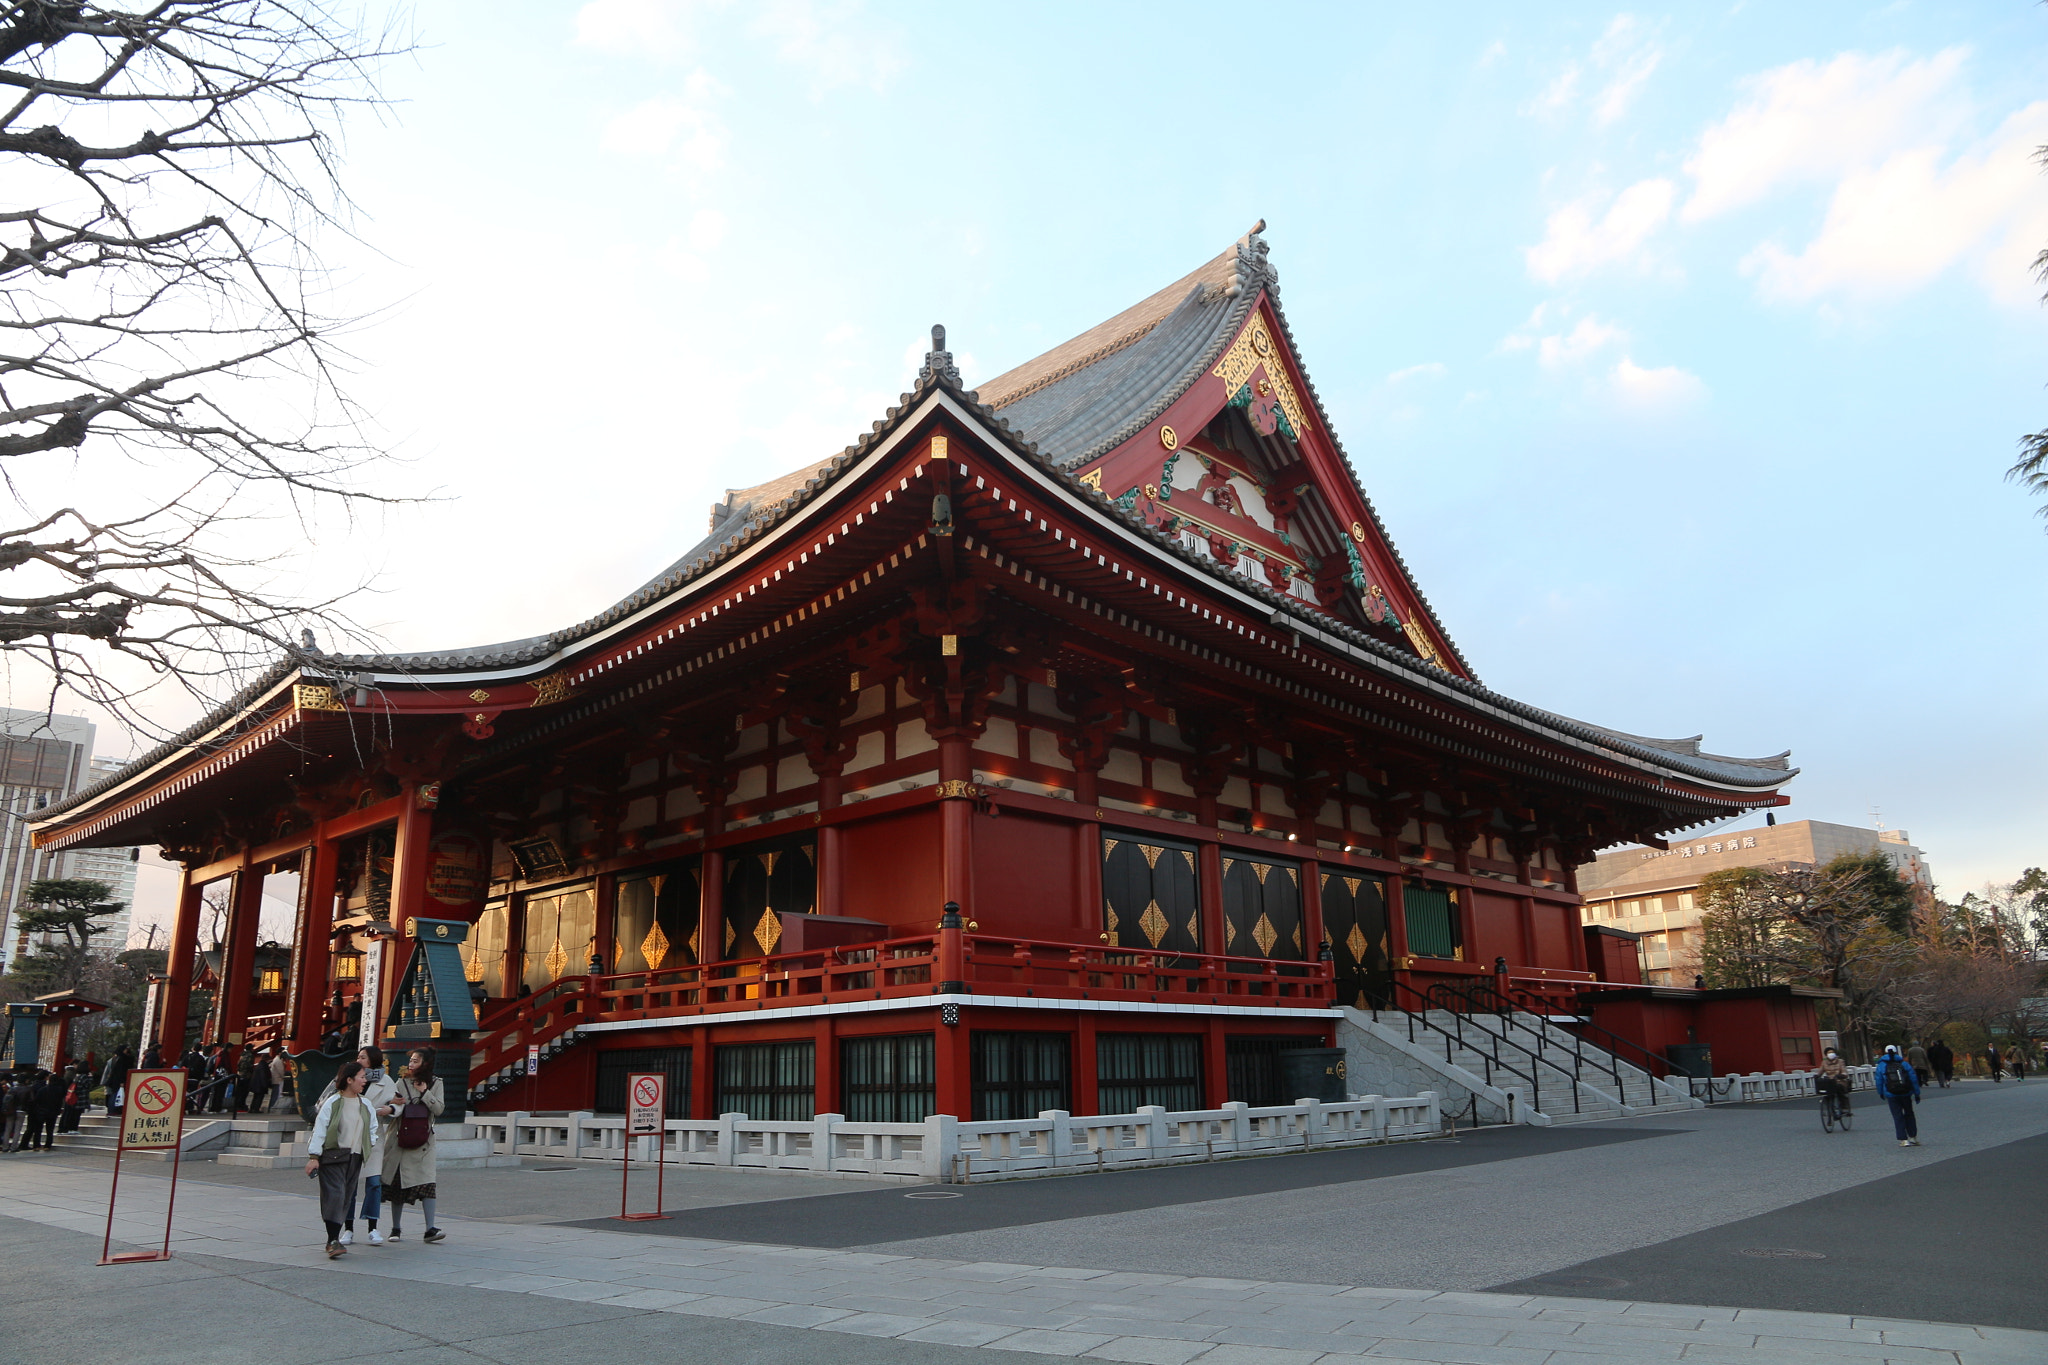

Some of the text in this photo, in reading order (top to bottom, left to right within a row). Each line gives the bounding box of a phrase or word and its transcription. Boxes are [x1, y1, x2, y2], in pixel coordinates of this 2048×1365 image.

[1680, 836, 1756, 858] 浅草寺病院
[134, 1116, 170, 1129] 自転車
[125, 1131, 175, 1143] 進入禁止
